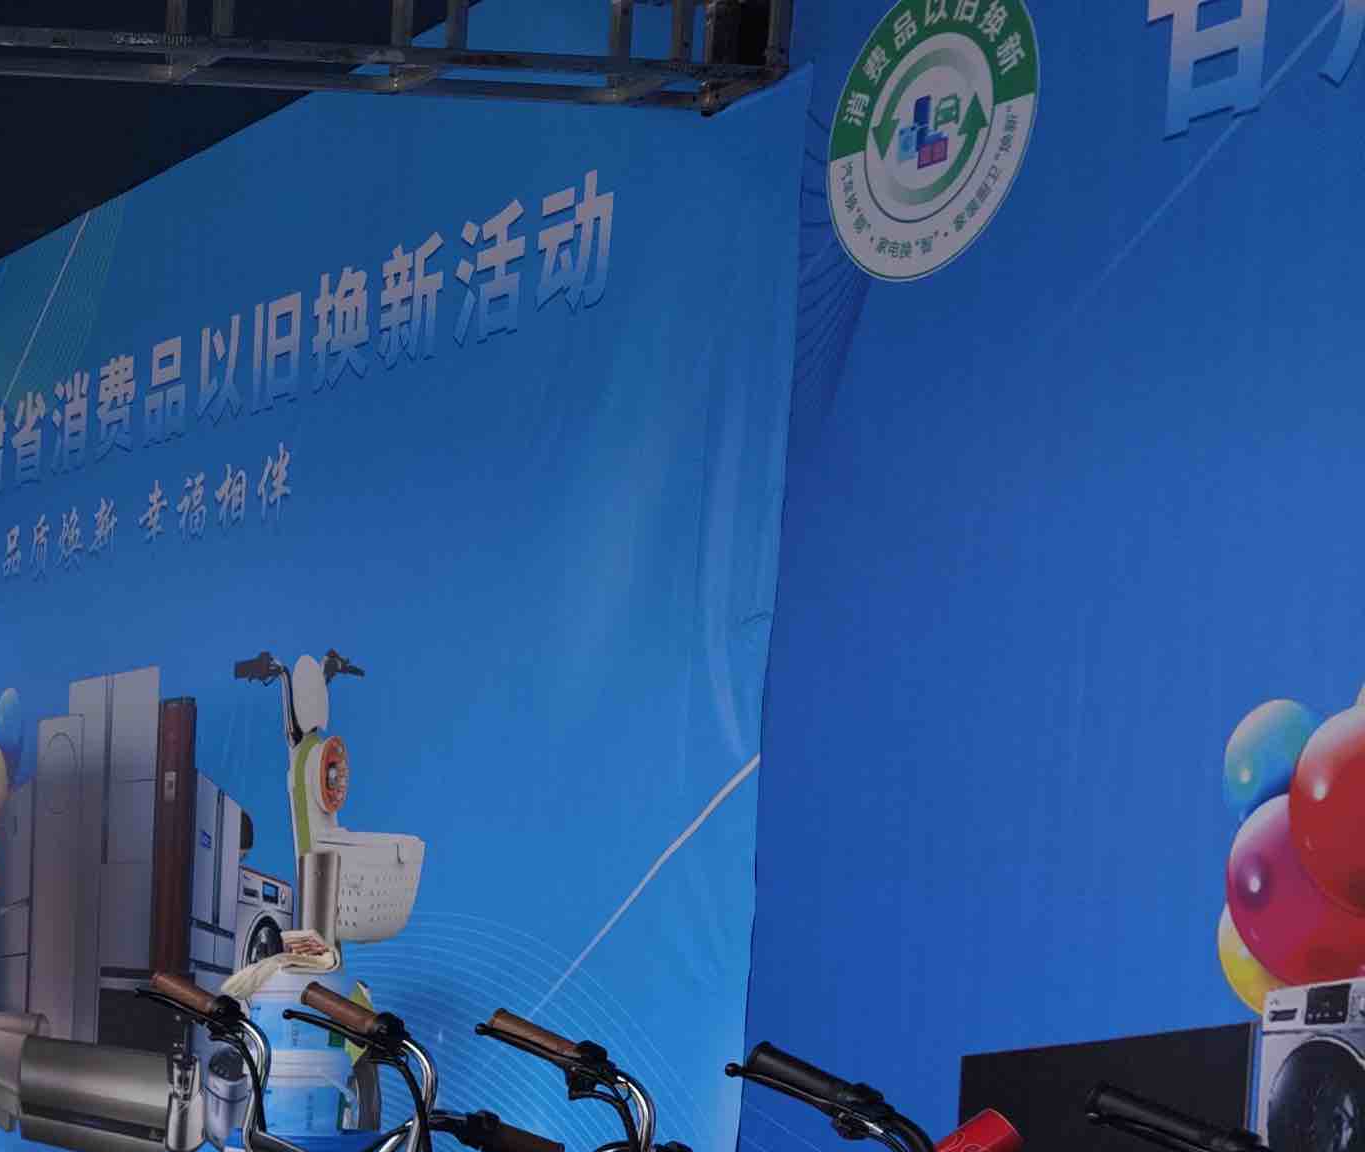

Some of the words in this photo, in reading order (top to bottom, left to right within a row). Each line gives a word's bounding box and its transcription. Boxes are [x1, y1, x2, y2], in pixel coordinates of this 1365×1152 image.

[0, 497, 118, 580] 品质焕新
[137, 442, 295, 545] 幸福相伴
